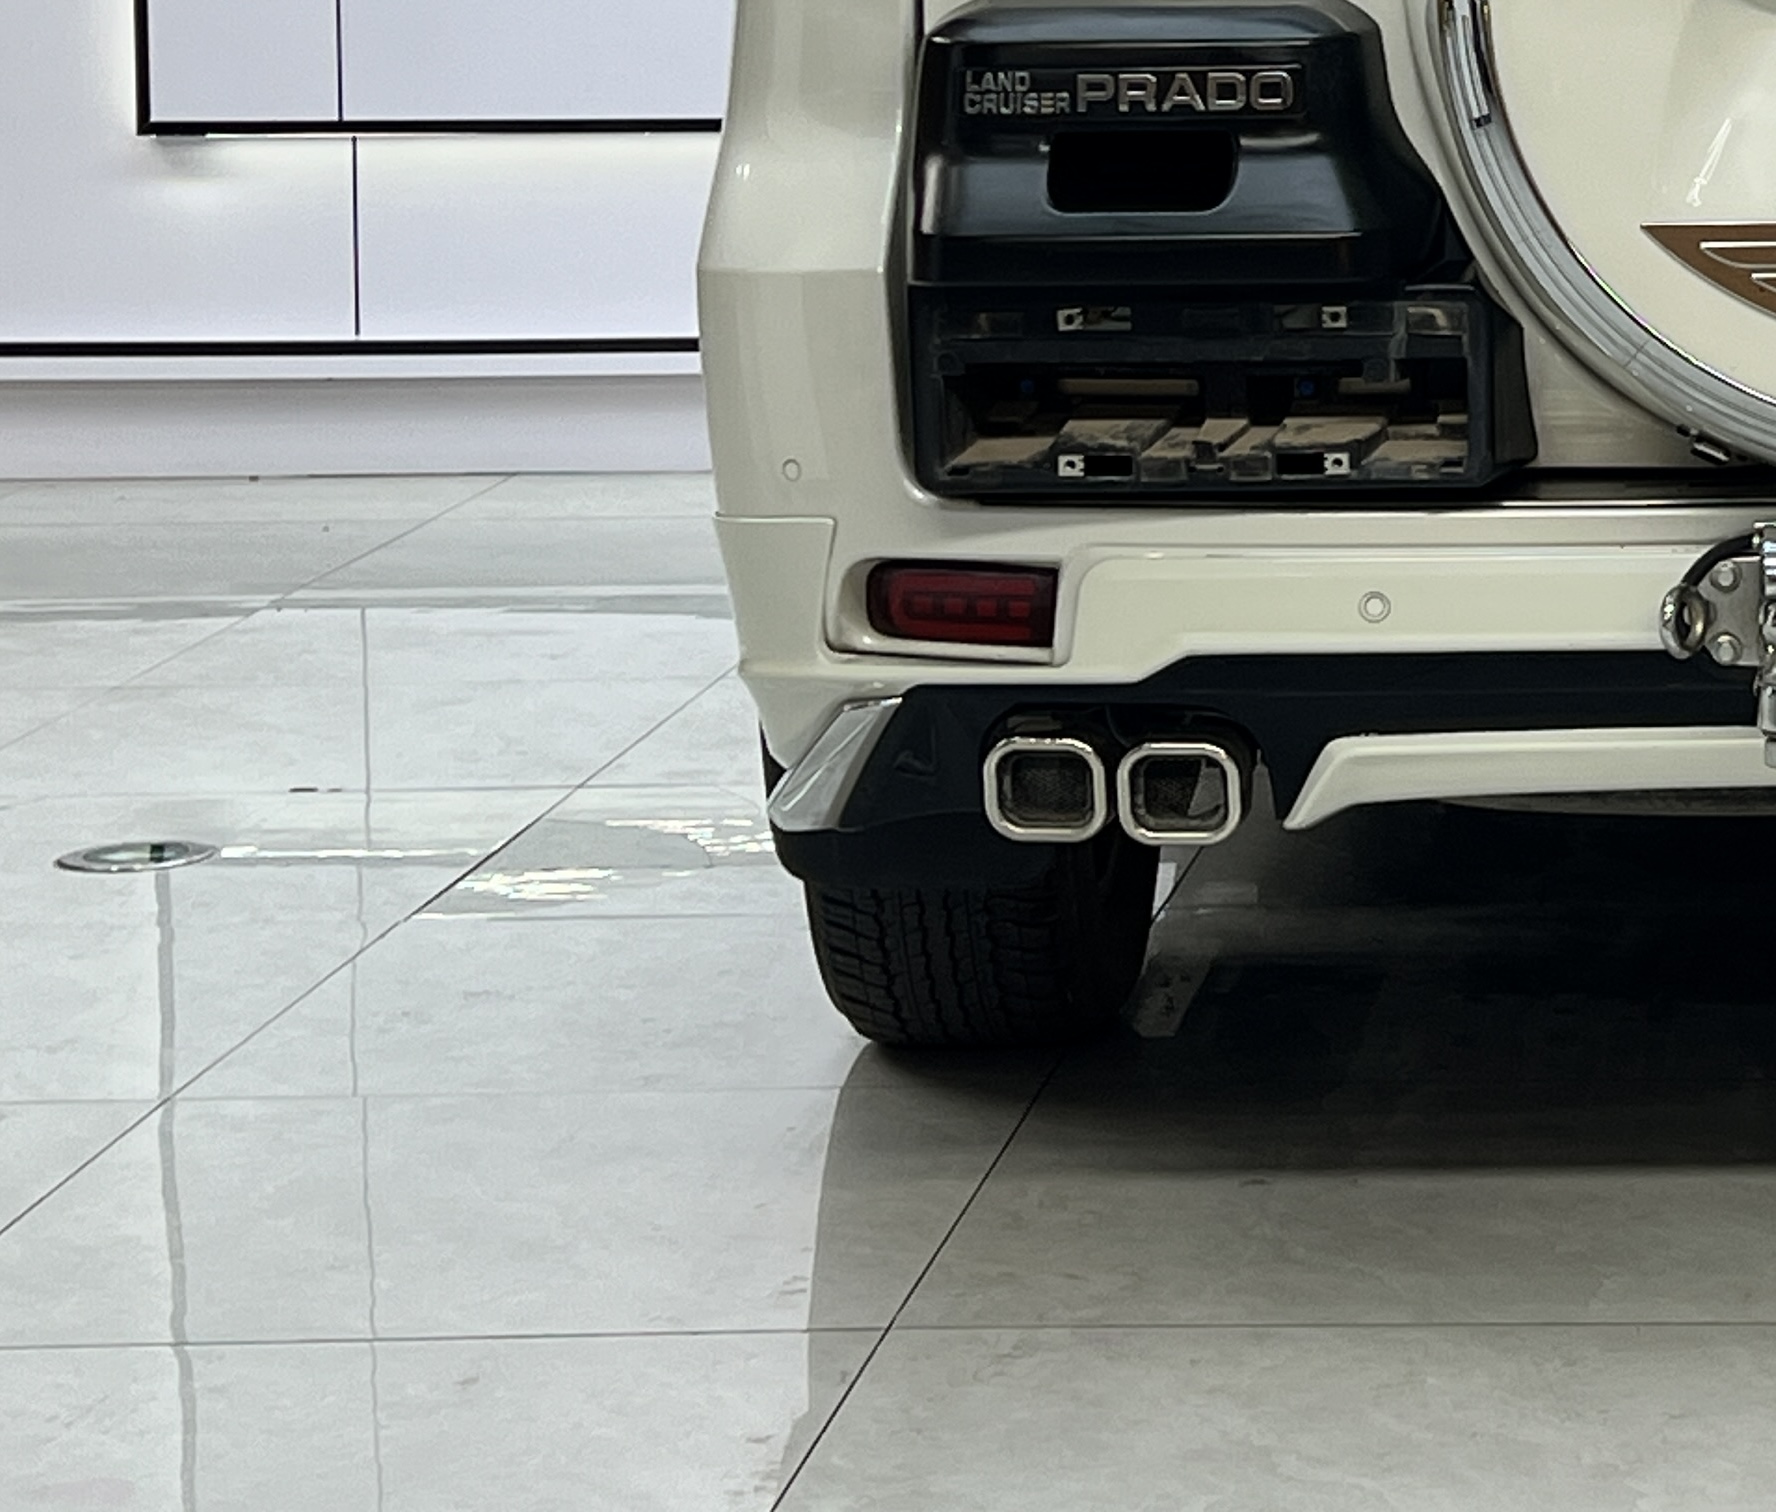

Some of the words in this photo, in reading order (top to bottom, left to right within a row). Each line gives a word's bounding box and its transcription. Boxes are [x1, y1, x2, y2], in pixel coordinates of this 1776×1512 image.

[965, 70, 1031, 92] LAND
[1076, 71, 1294, 113] PRADO
[963, 91, 1071, 115] CRUISER
